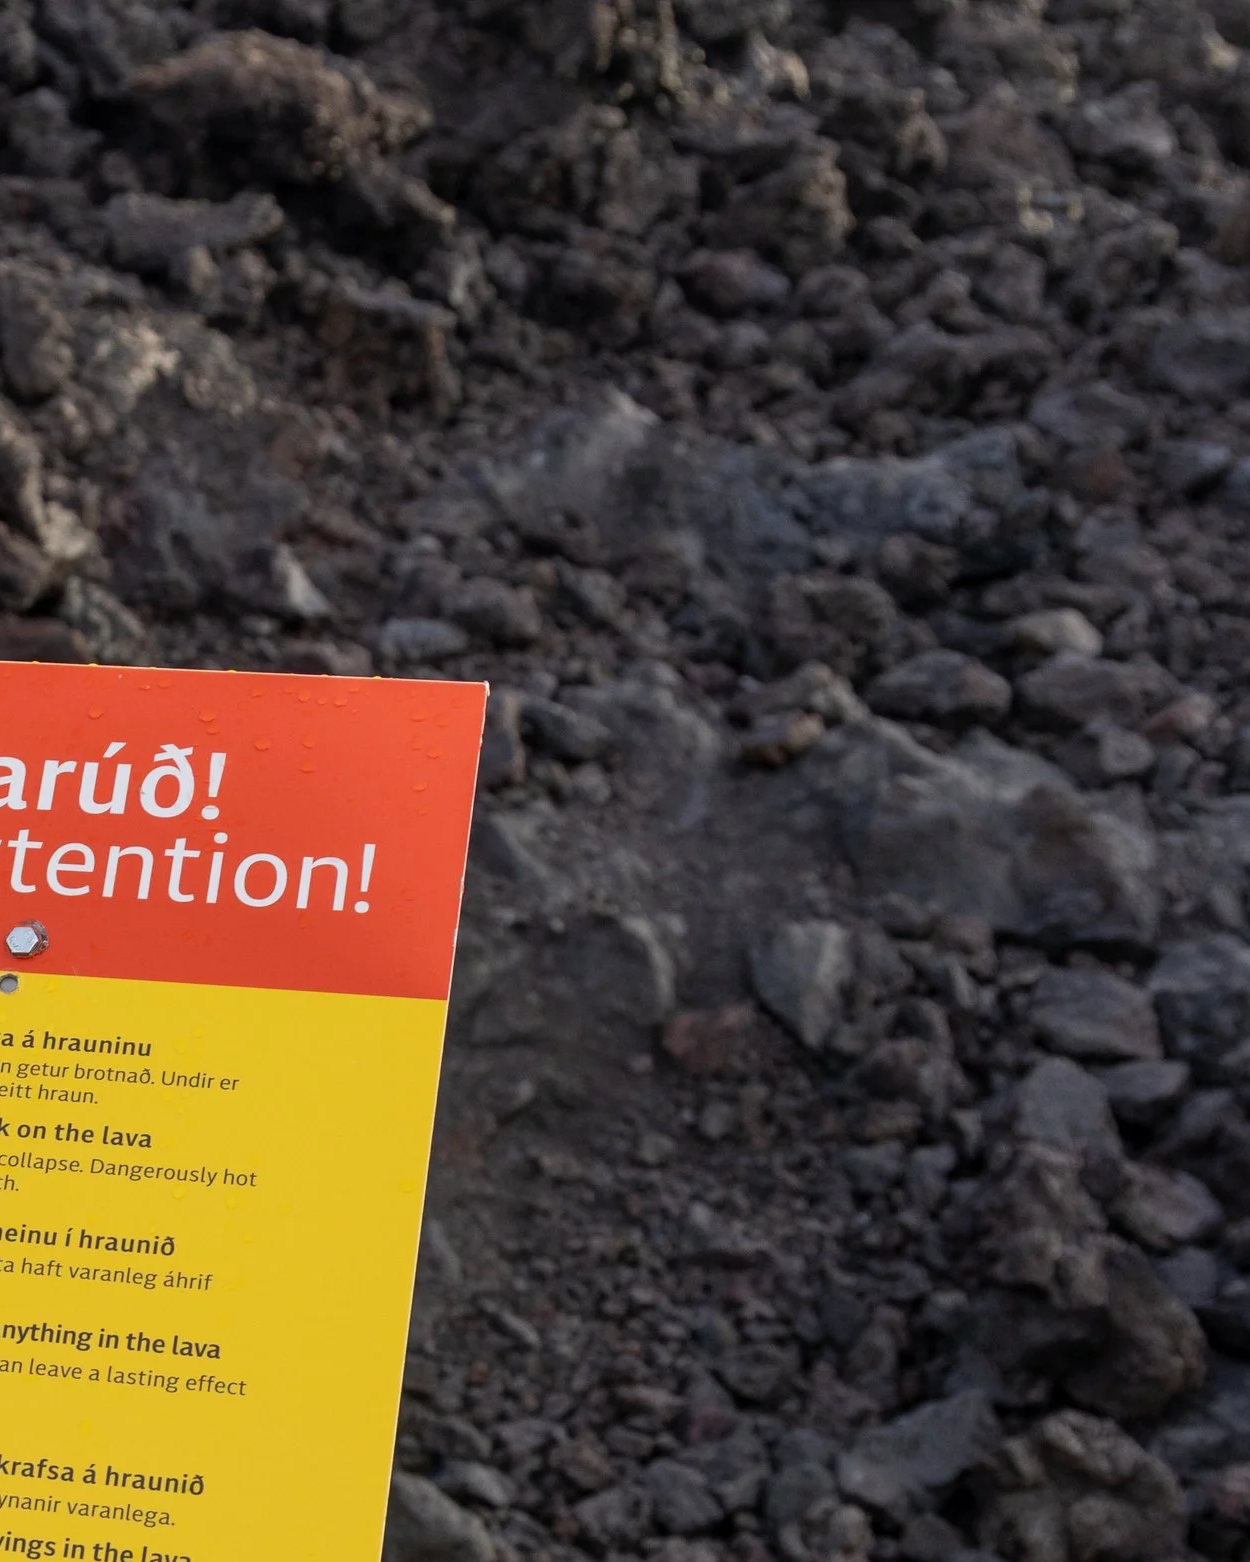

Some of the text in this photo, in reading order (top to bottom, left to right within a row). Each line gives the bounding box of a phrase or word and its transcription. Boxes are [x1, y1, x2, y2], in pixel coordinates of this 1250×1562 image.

[21, 1030, 35, 1049] á
[42, 1031, 152, 1057] hrauninu
[15, 1062, 70, 1080] getur
[73, 1063, 155, 1085] brotnað.
[161, 1070, 215, 1089] Undir
[219, 1078, 240, 1091] er
[37, 1083, 99, 1105] hraun.
[16, 1123, 47, 1140] on
[54, 1122, 95, 1144] the
[101, 1125, 153, 1149] lava
[89, 1158, 219, 1188] Dangerously
[222, 1168, 258, 1188] hot
[64, 1227, 74, 1248] í
[78, 1228, 175, 1257] hraunið
[20, 1257, 63, 1278] haft
[68, 1265, 158, 1290] varanleg
[162, 1270, 214, 1291] áhrif
[97, 1327, 120, 1350] in
[125, 1331, 166, 1354] the
[171, 1334, 221, 1360] lava
[28, 1357, 83, 1380] leave
[88, 1368, 100, 1382] a
[106, 1365, 180, 1394] lasting
[185, 1374, 247, 1396] effect
[81, 1463, 97, 1485] á
[104, 1465, 205, 1496] hraunið
[67, 1501, 175, 1529] varanlega.
[62, 1537, 86, 1560] in
